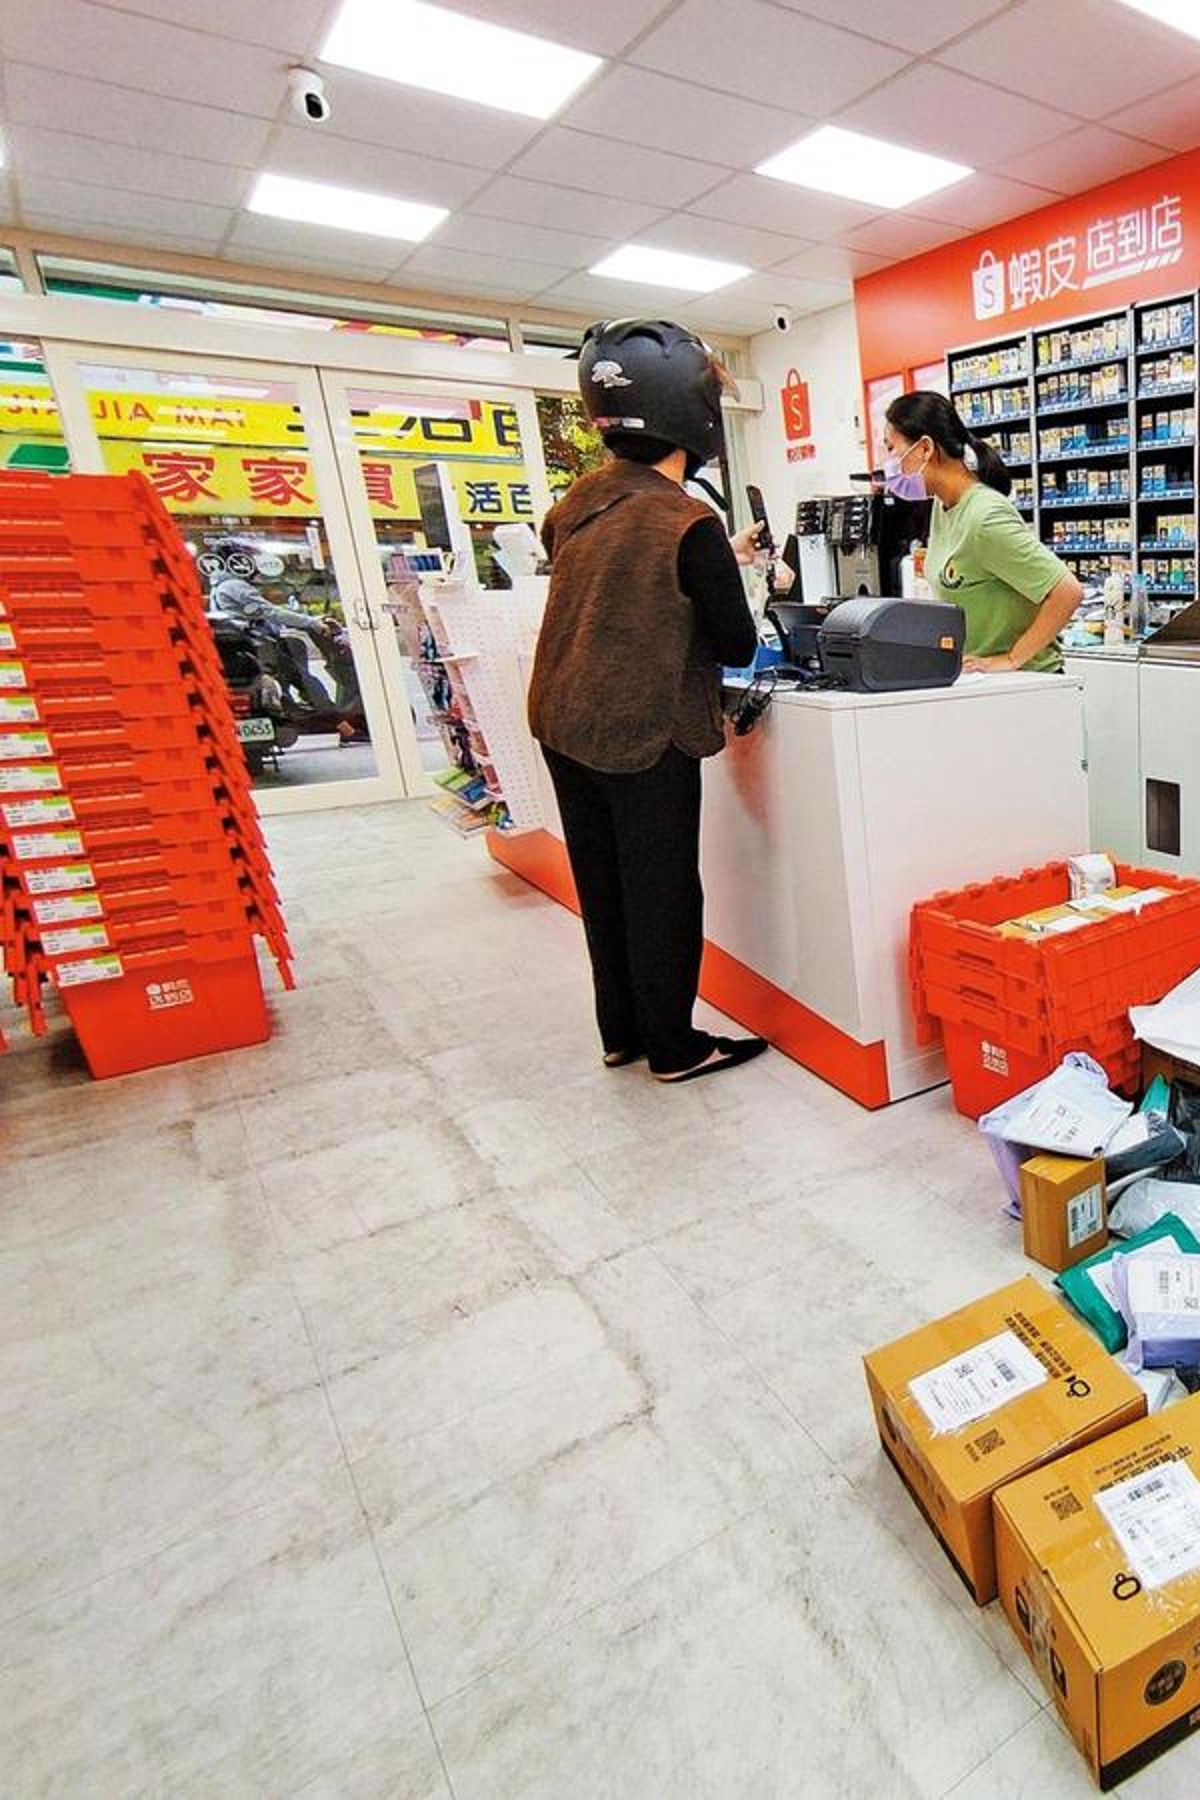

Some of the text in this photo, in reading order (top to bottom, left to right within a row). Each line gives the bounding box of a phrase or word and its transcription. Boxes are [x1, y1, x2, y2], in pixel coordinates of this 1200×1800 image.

[1008, 236, 1080, 311] 蝦皮
[1086, 196, 1183, 272] 店到店
[96, 399, 154, 422] JIA
